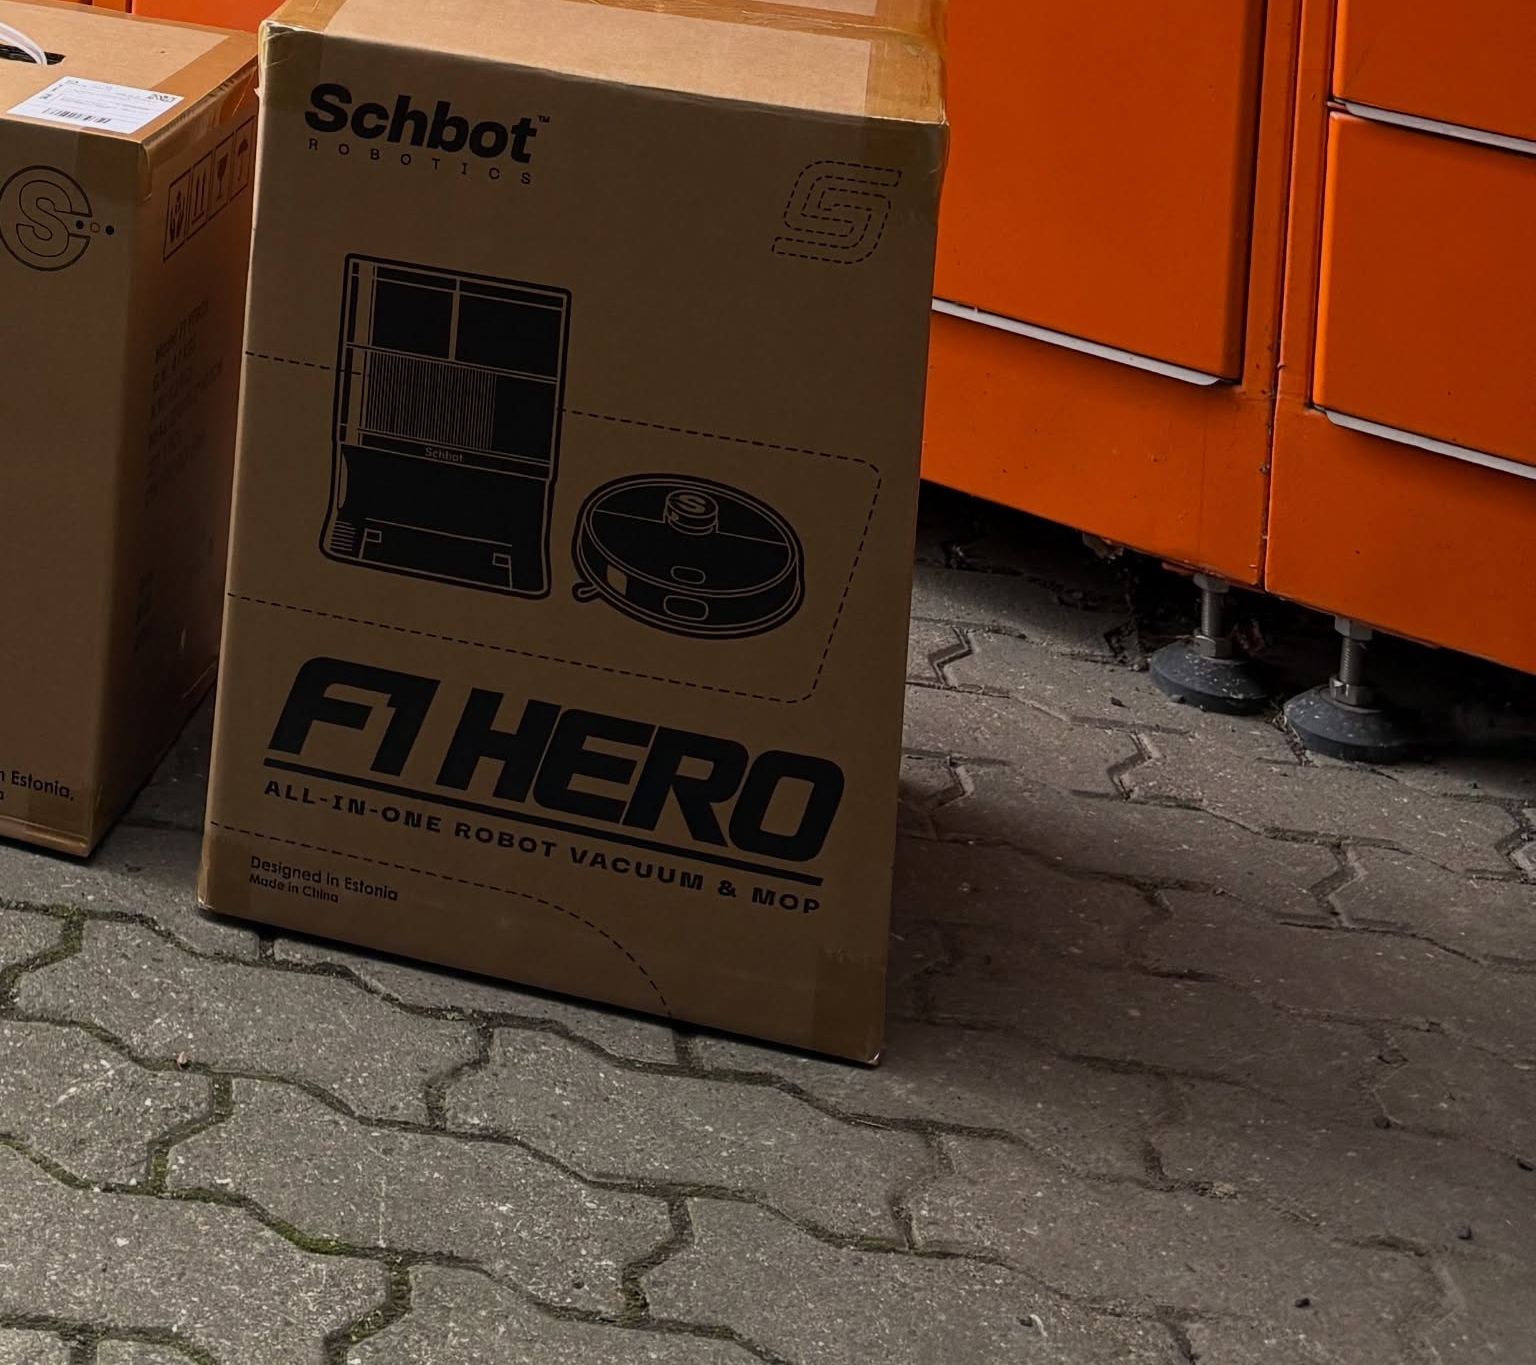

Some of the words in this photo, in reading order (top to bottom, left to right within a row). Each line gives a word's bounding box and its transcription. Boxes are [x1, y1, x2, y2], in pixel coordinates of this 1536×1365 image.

[308, 138, 533, 185] ROBOTICS
[424, 446, 465, 464] Schbot
[268, 656, 441, 777] F1
[436, 687, 845, 863] HERO
[264, 779, 442, 834] ALL-IN-ONE
[454, 822, 557, 859] ROBOT
[570, 846, 704, 892] VACUUM
[717, 878, 737, 899] &
[752, 887, 821, 915] MOP
[248, 873, 284, 891] Made
[287, 881, 299, 896] in
[302, 883, 339, 904] China
[250, 855, 322, 885] Designed
[326, 870, 340, 888] in
[344, 873, 399, 903] Estonia
